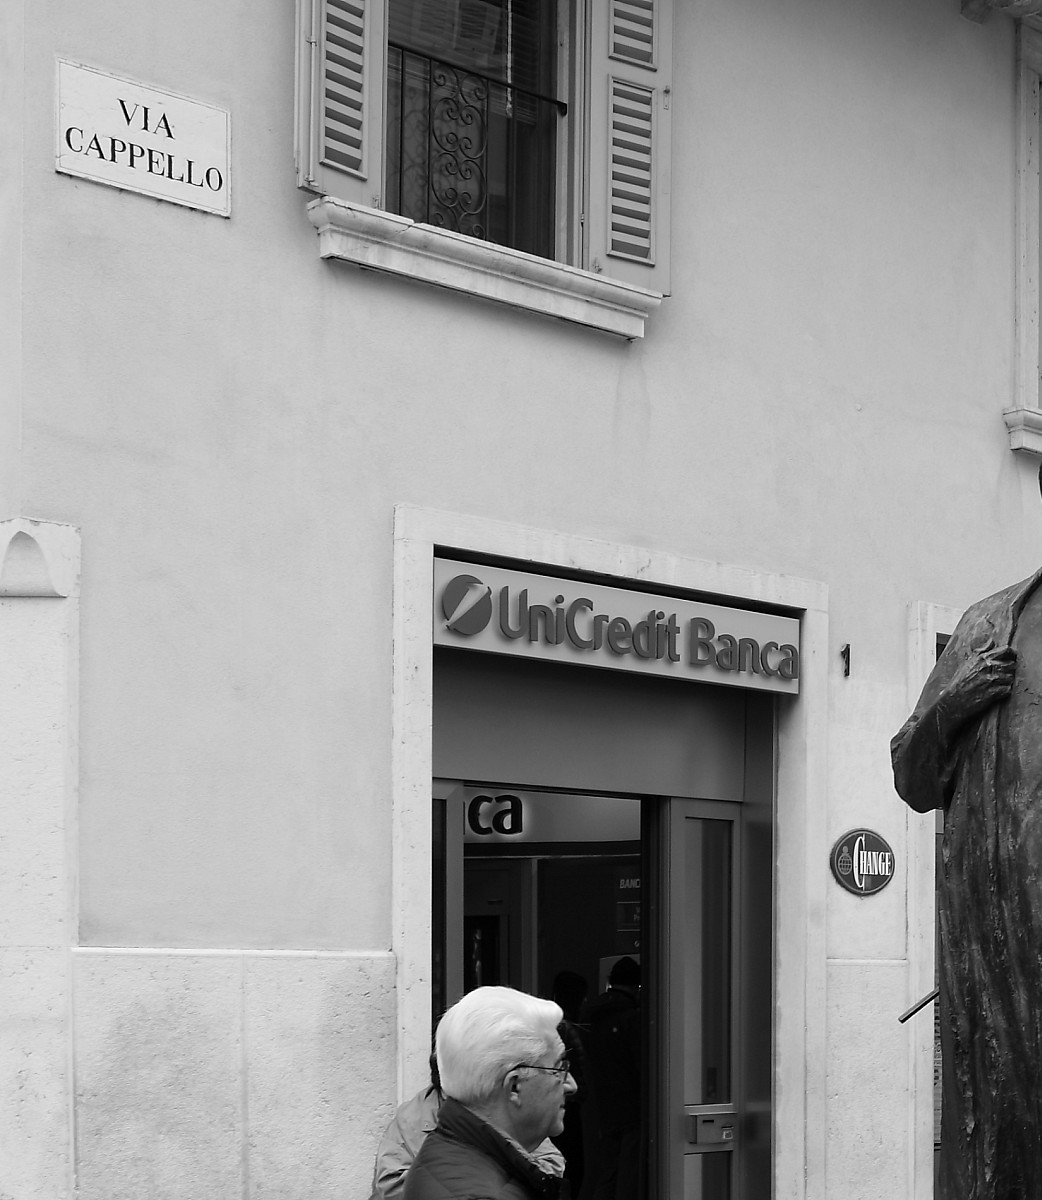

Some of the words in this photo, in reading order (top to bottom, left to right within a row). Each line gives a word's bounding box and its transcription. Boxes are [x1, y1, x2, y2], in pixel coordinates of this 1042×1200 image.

[117, 98, 175, 140] VIA
[65, 126, 223, 191] CAPPELLO
[499, 585, 681, 663] UniCredit
[689, 616, 800, 680] Banca
[840, 643, 851, 678] 1
[464, 794, 523, 836] ca
